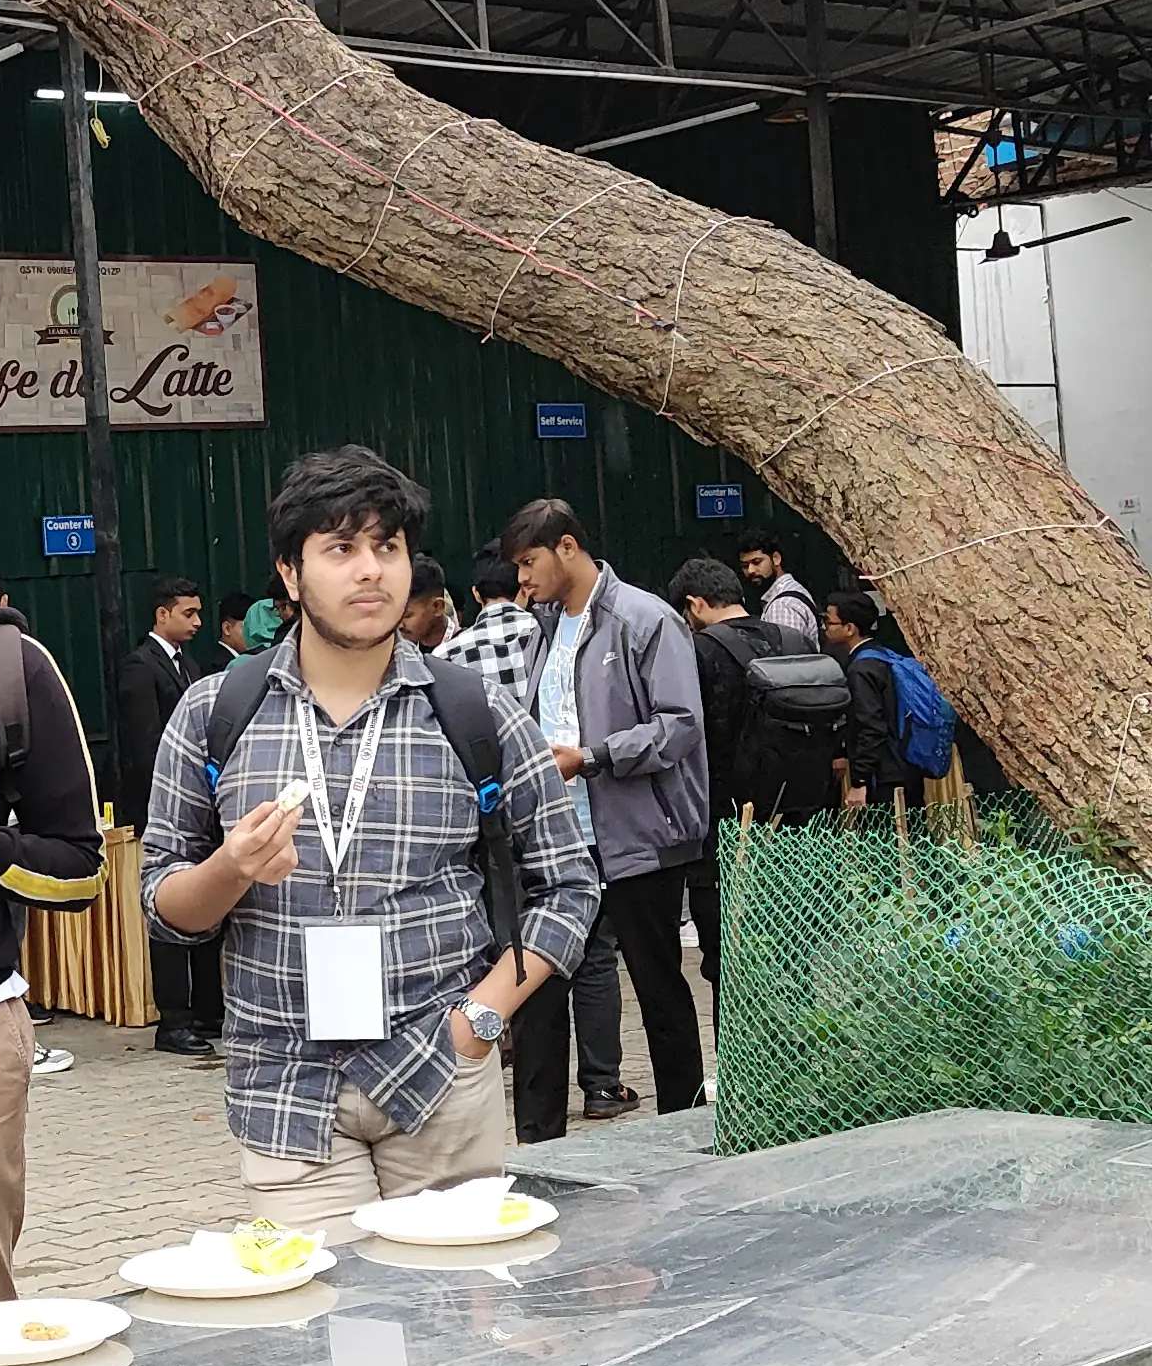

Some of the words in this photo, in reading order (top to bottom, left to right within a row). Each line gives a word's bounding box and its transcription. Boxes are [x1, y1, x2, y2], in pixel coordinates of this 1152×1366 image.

[109, 344, 234, 417] Latte
[540, 416, 556, 426] Self
[556, 416, 583, 426] Service
[46, 519, 83, 531] Counter
[70, 535, 78, 547] 3
